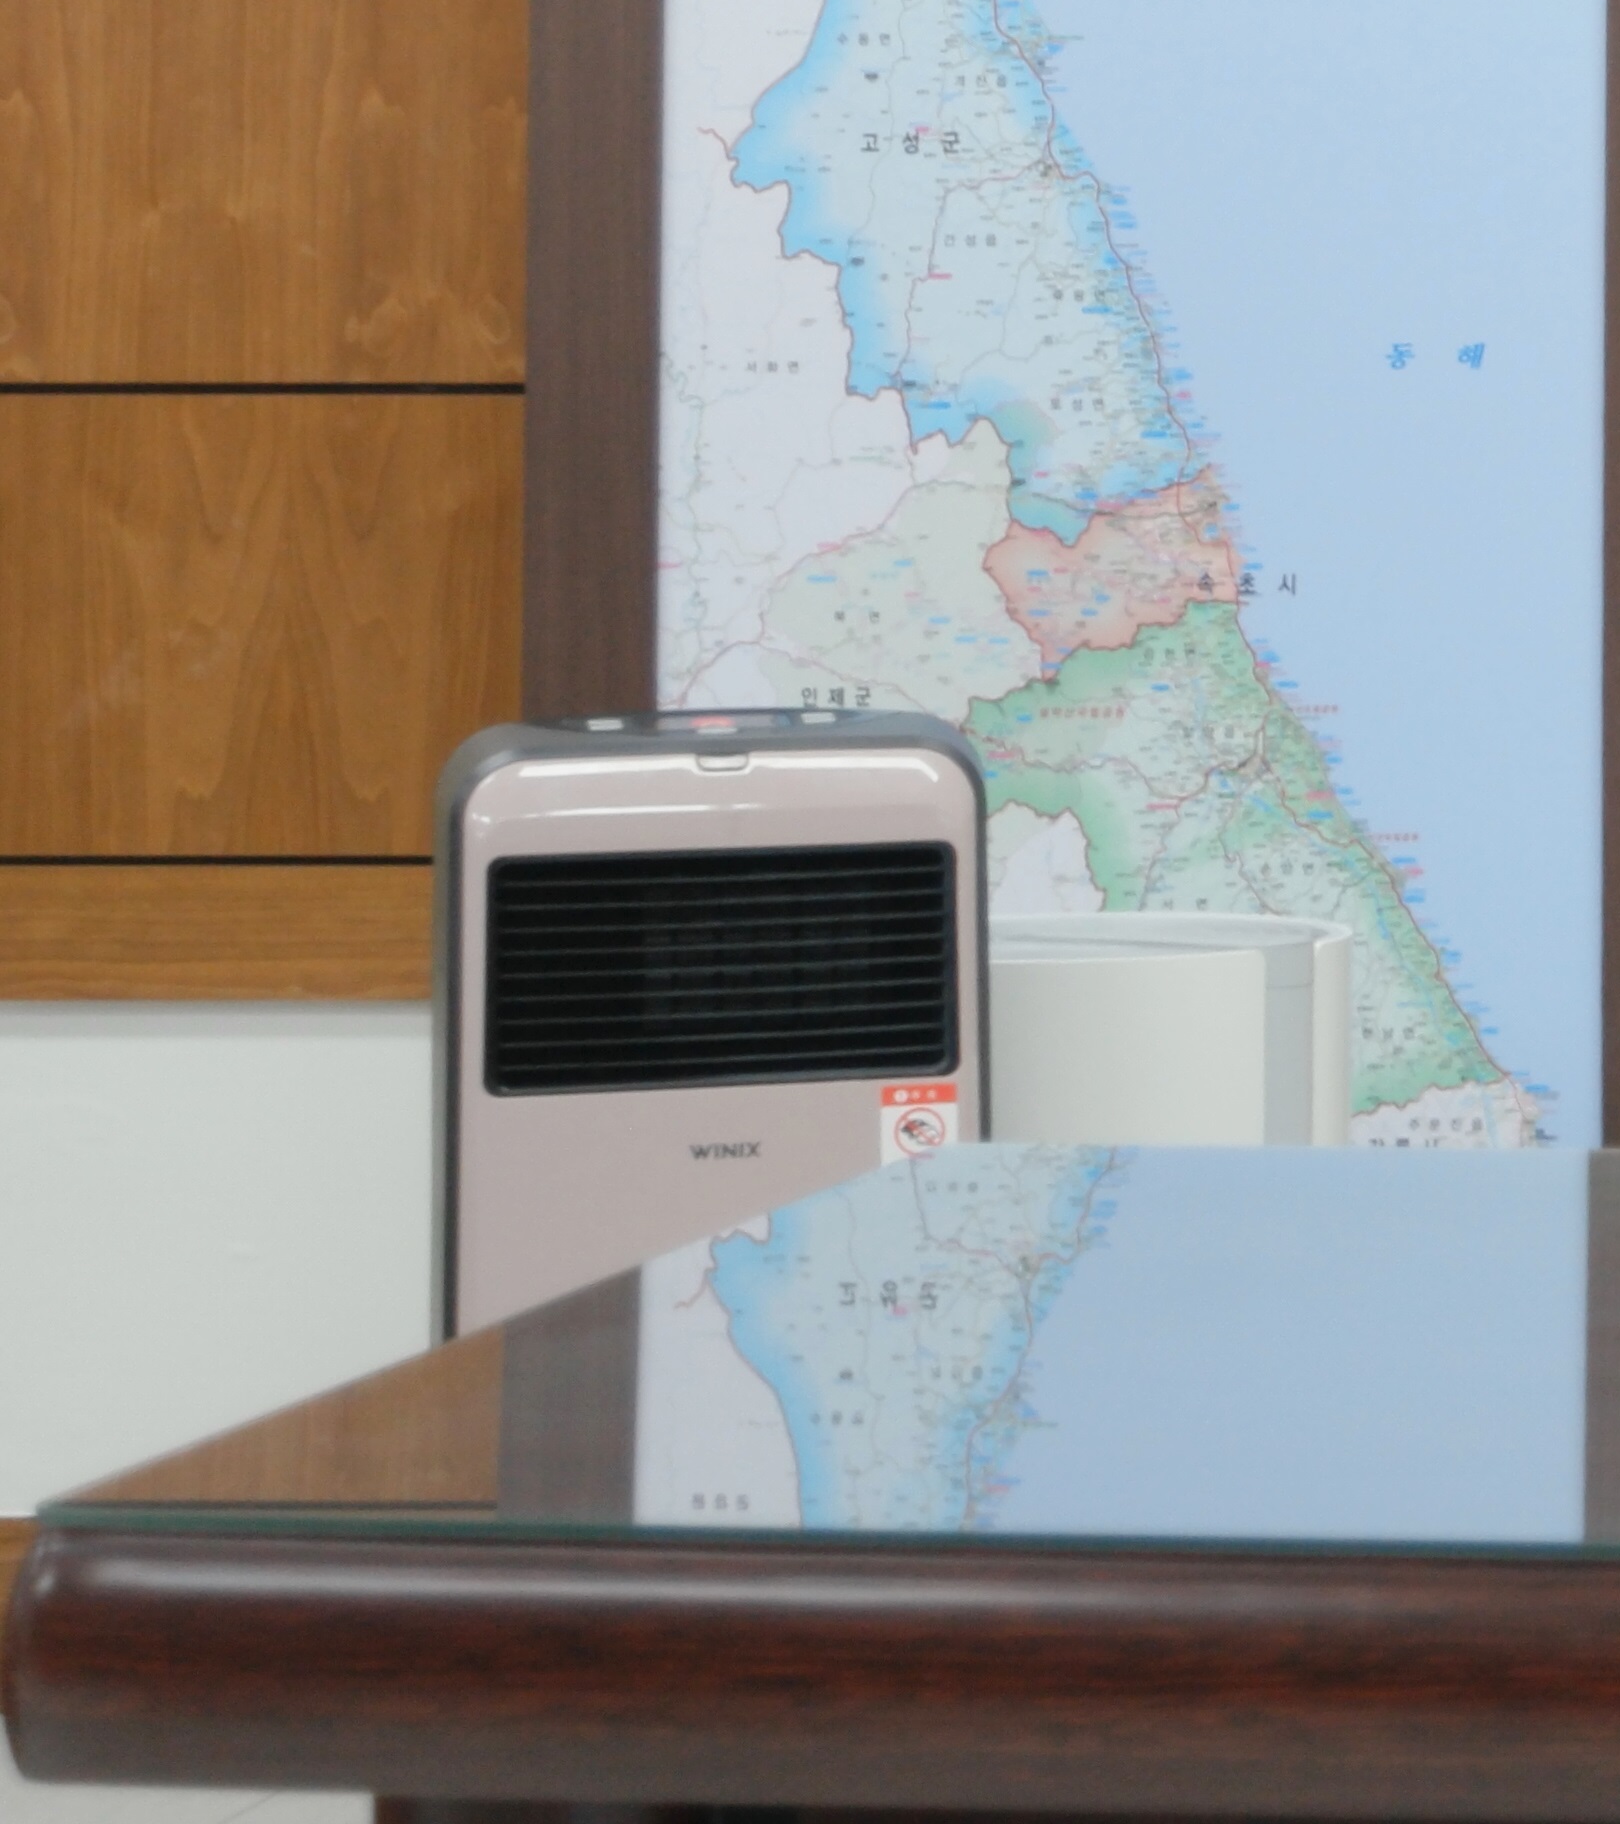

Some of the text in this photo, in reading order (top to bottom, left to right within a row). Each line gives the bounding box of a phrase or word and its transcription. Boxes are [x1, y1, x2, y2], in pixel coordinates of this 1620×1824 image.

[860, 131, 961, 154] 고성군
[1385, 340, 1486, 370] 동해
[801, 686, 871, 707] 인제군
[689, 1141, 761, 1160] WINIX
